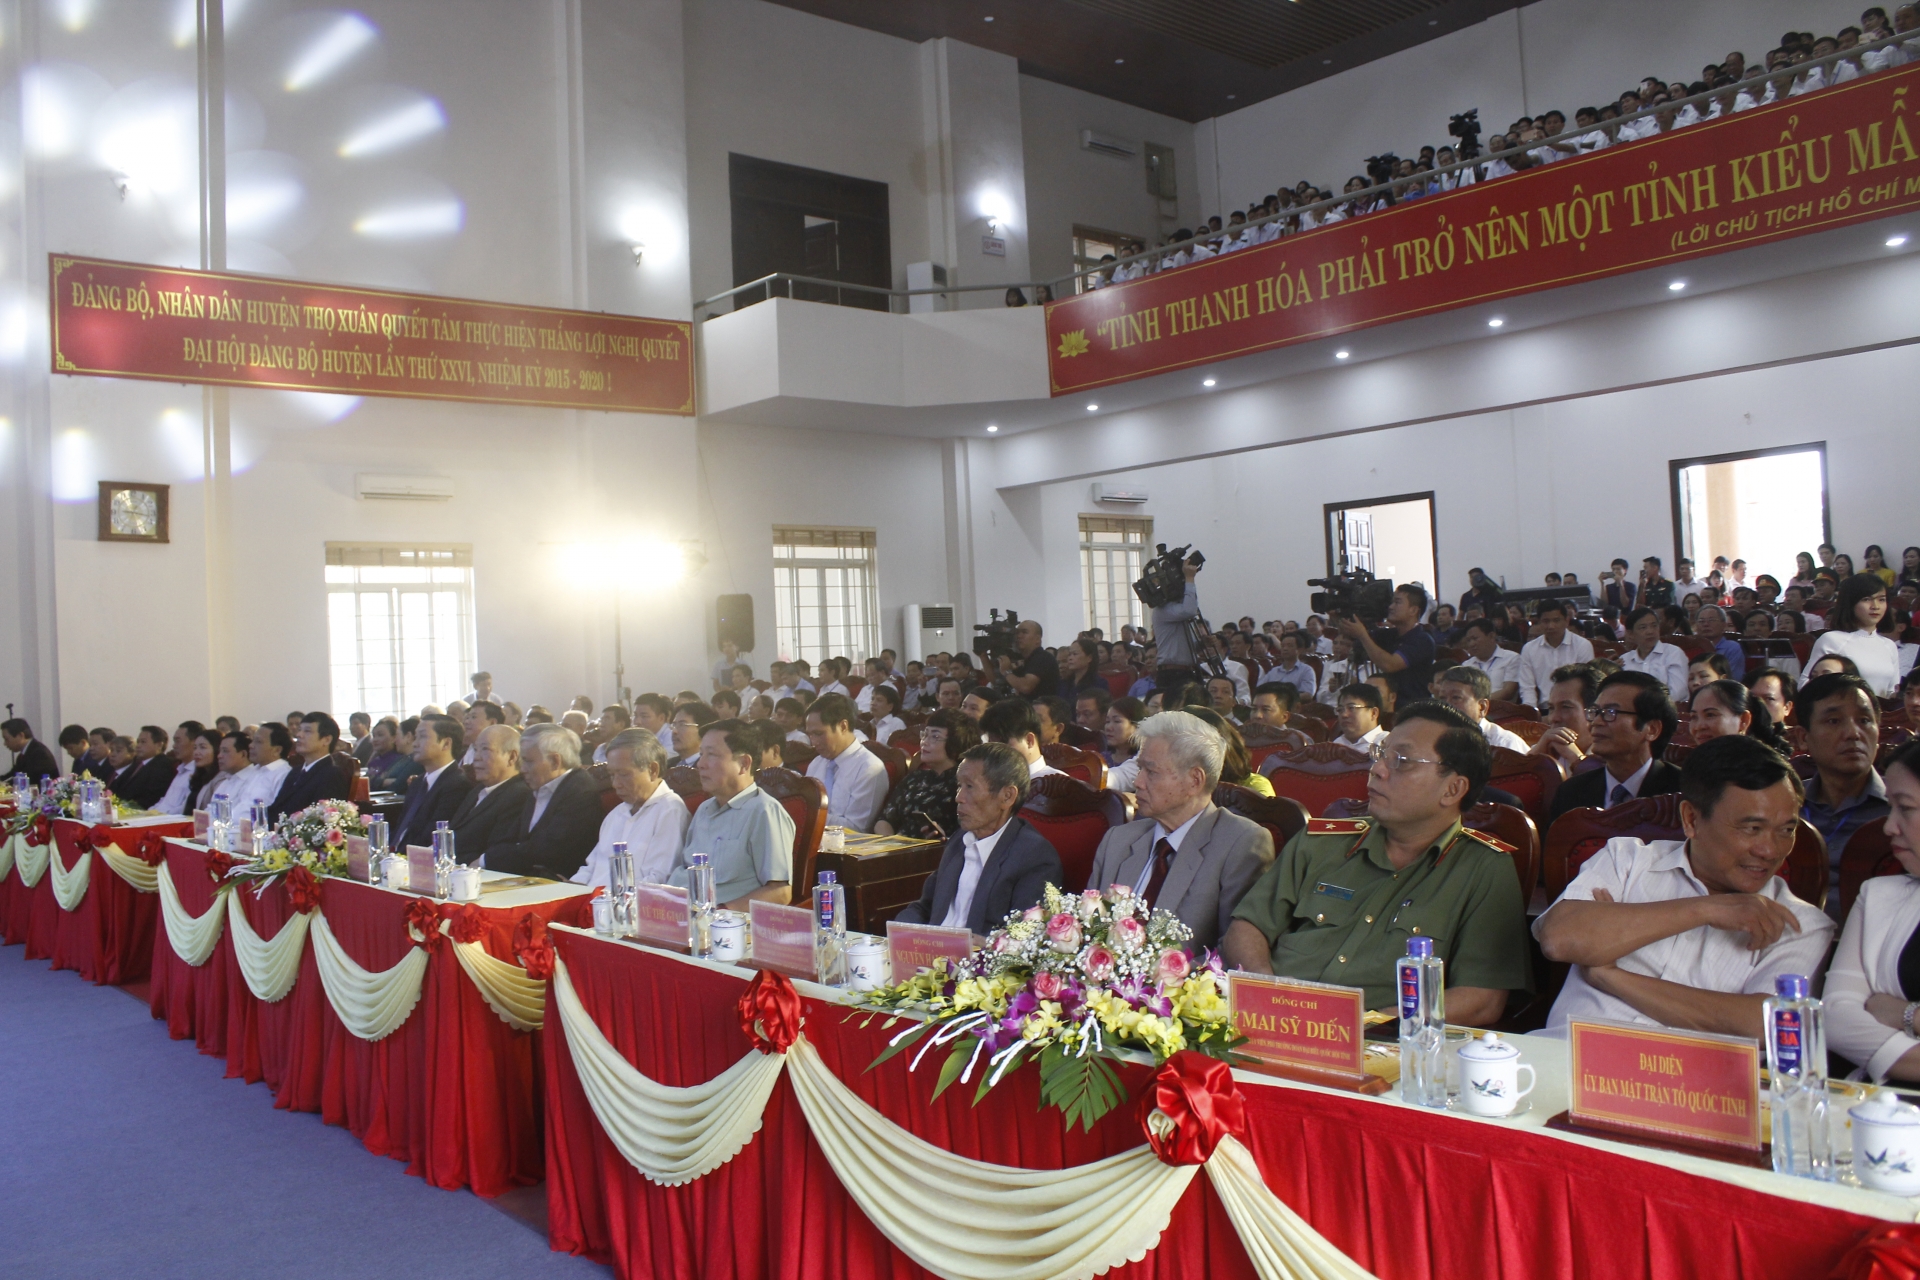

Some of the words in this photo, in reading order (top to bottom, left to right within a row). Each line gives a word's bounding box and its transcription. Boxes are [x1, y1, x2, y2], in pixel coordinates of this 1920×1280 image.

[1165, 283, 1250, 336] THANH
[1255, 262, 1314, 315] HÓA
[1318, 235, 1388, 300] PHẢI
[1393, 214, 1455, 281] TRỞ
[1462, 205, 1530, 265] NÊN
[1538, 184, 1615, 252] MỘT
[1623, 161, 1719, 227] TỈNH
[1728, 114, 1833, 204] KIỂU
[1844, 85, 1920, 176] MẪ
[1671, 223, 1710, 251] (LỜI
[1715, 211, 1759, 238] CHỦ
[1764, 201, 1813, 229] TỊCH
[1818, 186, 1853, 215] HỒ
[1858, 176, 1900, 205] CHÍ
[72, 273, 122, 311] ĐẢNG
[126, 281, 154, 320] BỘ,
[157, 285, 204, 318] NHÂN
[208, 290, 242, 322] DÂN
[247, 296, 300, 333] HUYỆN
[303, 305, 335, 337] THỌ
[337, 304, 378, 335] XUÂN
[381, 307, 428, 341] QUYẾT
[432, 313, 461, 342] TÂM
[464, 320, 501, 350] THỰC
[504, 320, 536, 354] HIỆN
[539, 319, 582, 353] THẮNG
[585, 330, 606, 360] LỢI
[609, 335, 639, 363] NGHỊ
[641, 331, 680, 362] QUYẾT
[183, 337, 212, 368] ĐẠI
[216, 333, 247, 372] HỘI
[249, 335, 293, 370] ĐẢNG
[297, 341, 318, 378] BỘ
[322, 345, 374, 380] HUYỆN
[376, 343, 405, 377] LẦN
[408, 350, 437, 380] THỨ
[440, 358, 475, 387] XXVI,
[477, 357, 522, 390] NHIỆM
[525, 359, 542, 388] KỲ
[544, 368, 570, 389] 2015
[579, 371, 604, 391] 2020
[1242, 1011, 1276, 1032] MAI
[1280, 1015, 1302, 1036] SỸ
[1306, 1017, 1351, 1043] DIẾN
[1778, 1031, 1798, 1046] 3A
[1639, 1053, 1658, 1075] ĐẠI
[1659, 1054, 1683, 1079] DIỆN
[1599, 1076, 1619, 1096] BAN
[1620, 1078, 1642, 1102] MẶT
[1643, 1082, 1670, 1107] TRẬN
[1671, 1082, 1686, 1108] TỔ
[1688, 1087, 1717, 1113] QUỐC
[1720, 1091, 1747, 1118] TỈNH
